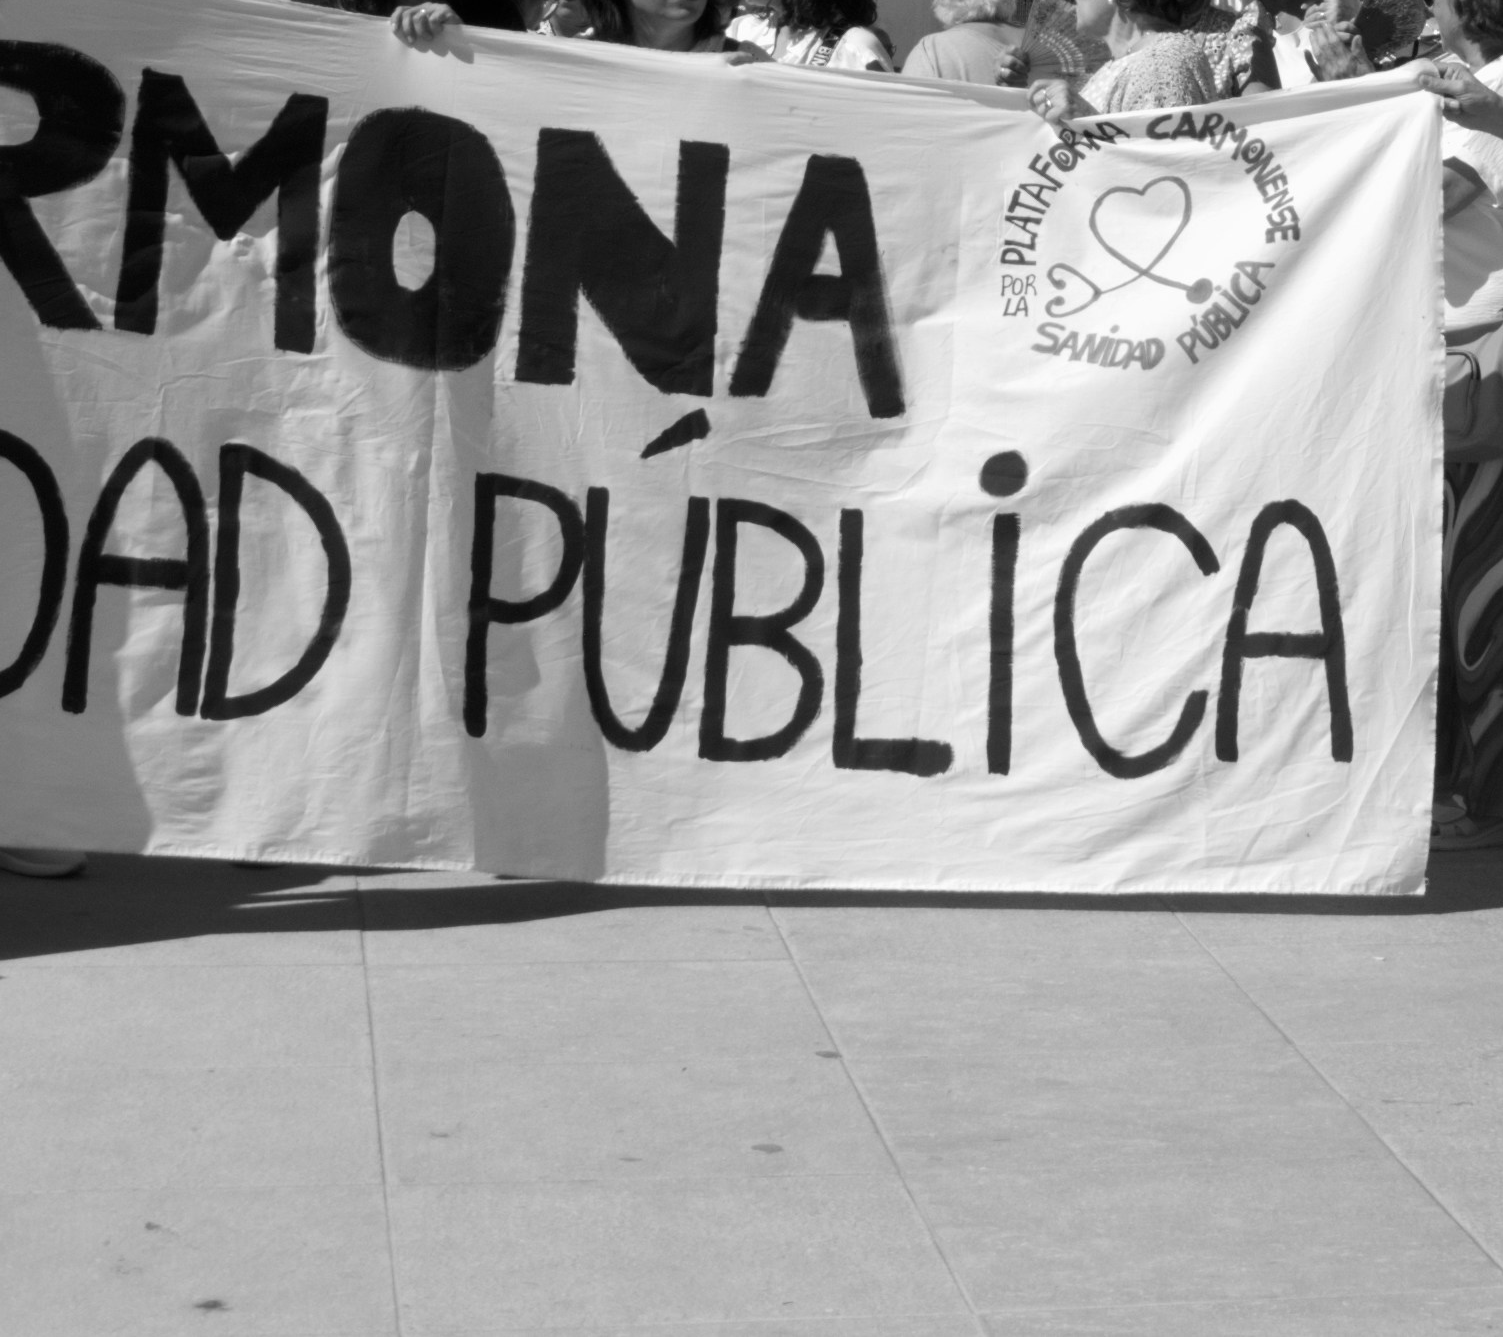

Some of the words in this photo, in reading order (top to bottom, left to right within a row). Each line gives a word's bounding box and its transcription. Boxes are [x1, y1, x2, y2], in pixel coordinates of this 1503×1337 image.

[1145, 111, 1301, 244] CARMONENSE
[1001, 274, 1038, 298] POR
[1002, 295, 1030, 318] LA
